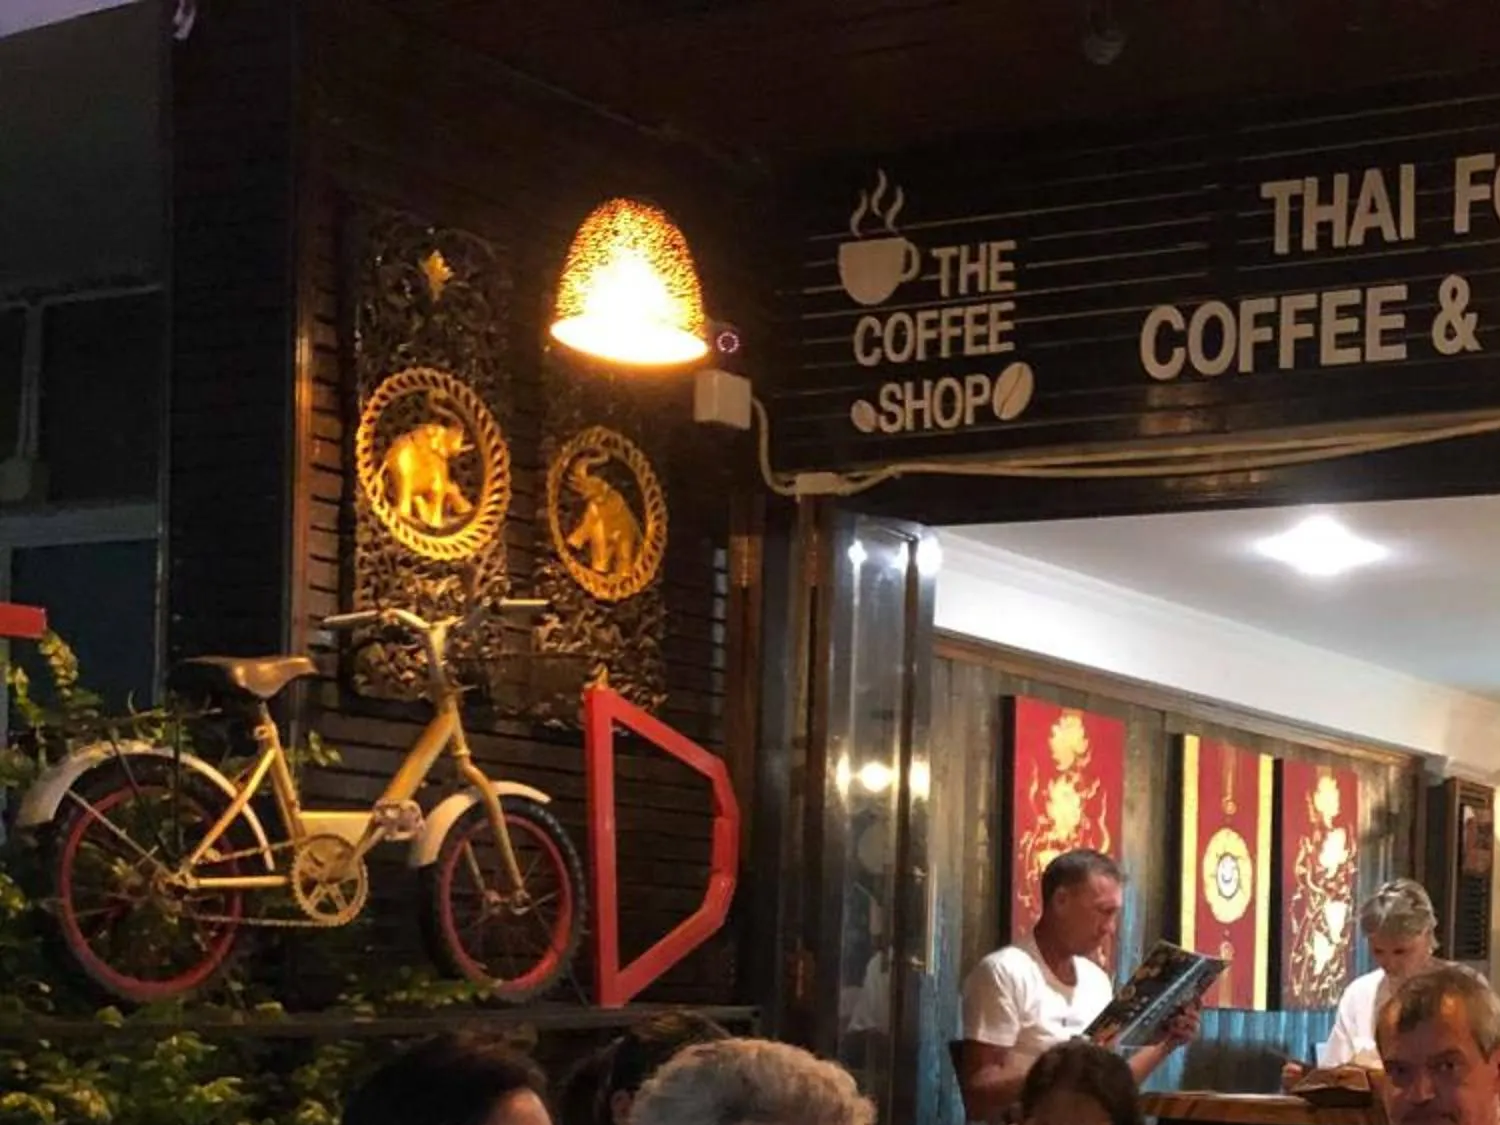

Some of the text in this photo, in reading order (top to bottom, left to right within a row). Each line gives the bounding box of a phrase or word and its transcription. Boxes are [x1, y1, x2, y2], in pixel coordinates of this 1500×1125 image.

[1261, 163, 1415, 254] THAI
[931, 239, 1017, 297] THE
[853, 300, 1016, 367] COFFEE
[1141, 284, 1408, 380] COFFEE
[1431, 274, 1483, 354] &
[879, 373, 992, 433] SHOP
